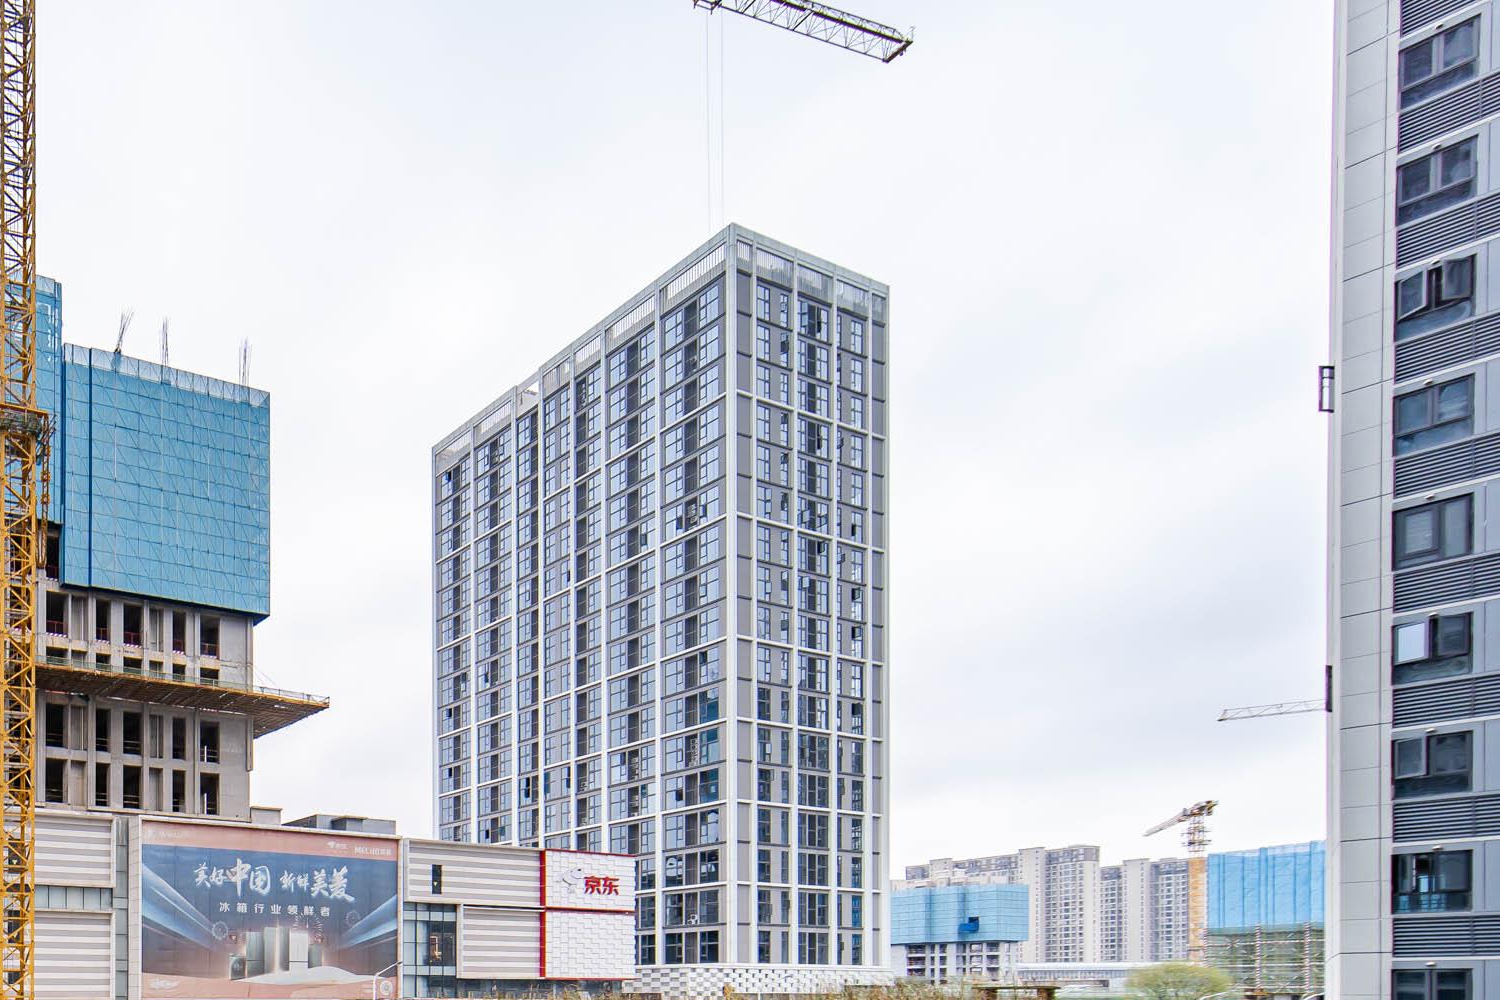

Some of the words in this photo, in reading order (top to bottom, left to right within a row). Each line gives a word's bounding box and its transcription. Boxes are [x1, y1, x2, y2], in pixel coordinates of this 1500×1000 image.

[193, 858, 271, 897] 美好中国
[279, 865, 355, 903] 新鲜美菱
[583, 876, 619, 895] 京东
[219, 902, 330, 917] 冰箱行业领鲜者
